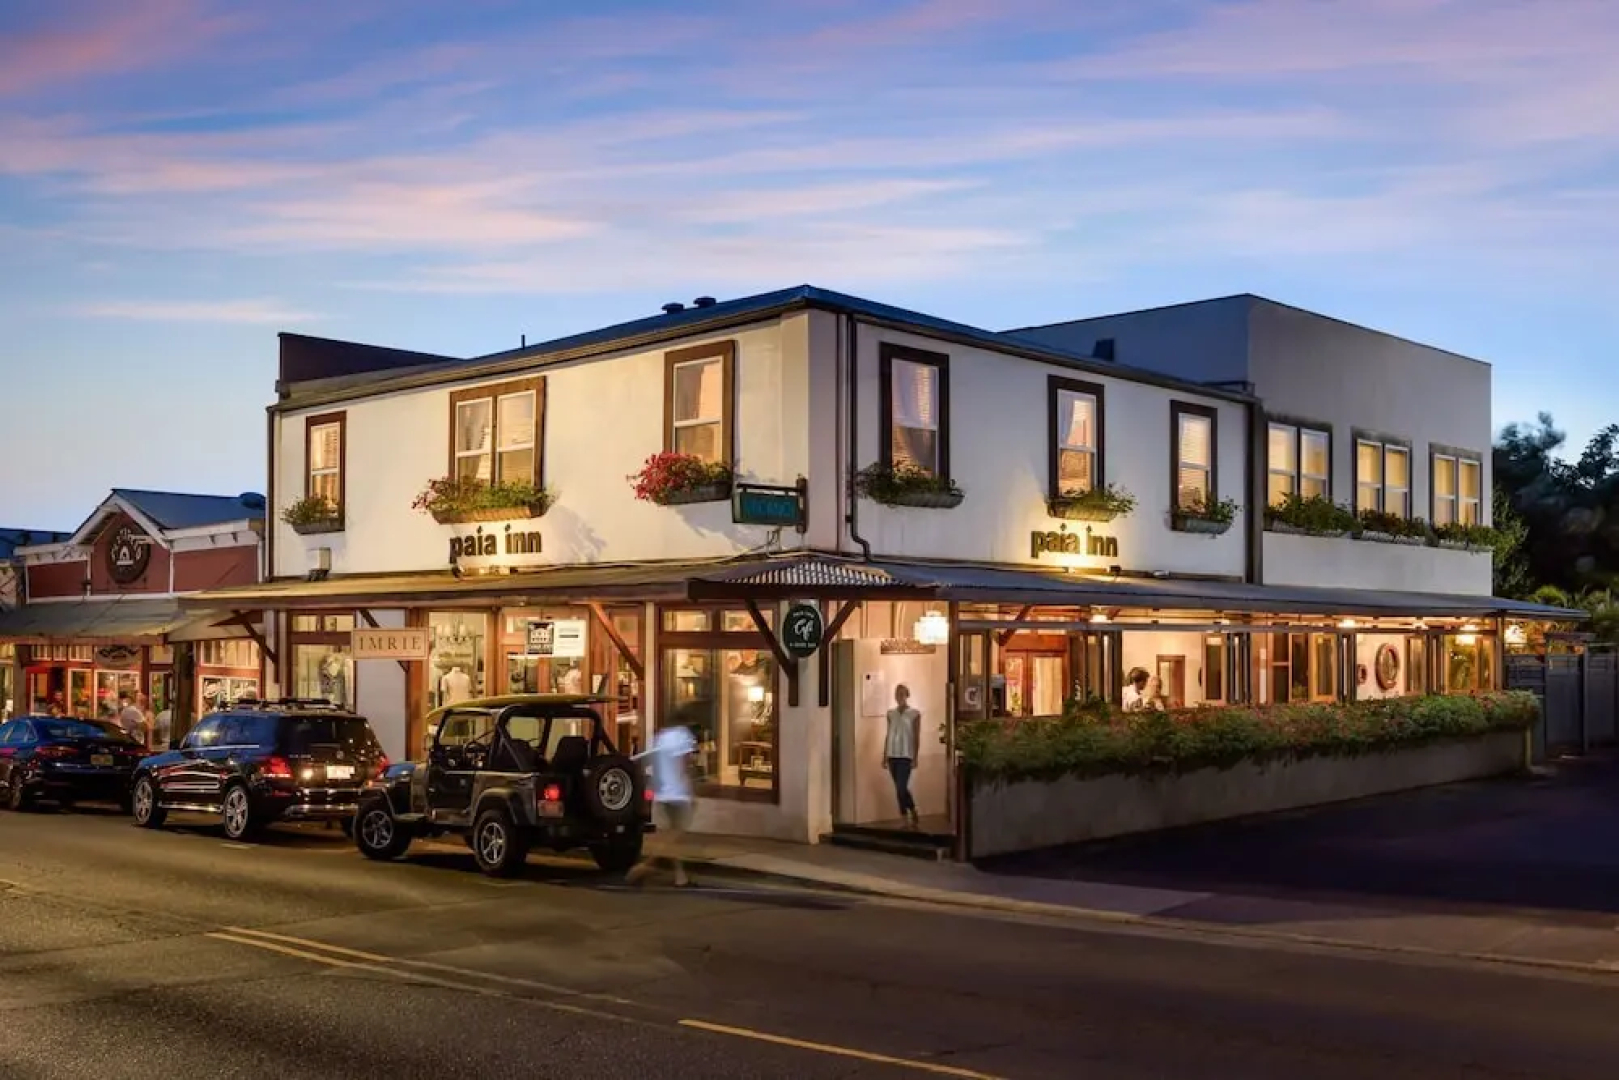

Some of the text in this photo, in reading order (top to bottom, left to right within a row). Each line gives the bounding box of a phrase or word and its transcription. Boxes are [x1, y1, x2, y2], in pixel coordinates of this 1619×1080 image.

[449, 523, 542, 564] paia inn
[1031, 523, 1118, 559] paia inn
[360, 636, 421, 650] IMRIE
